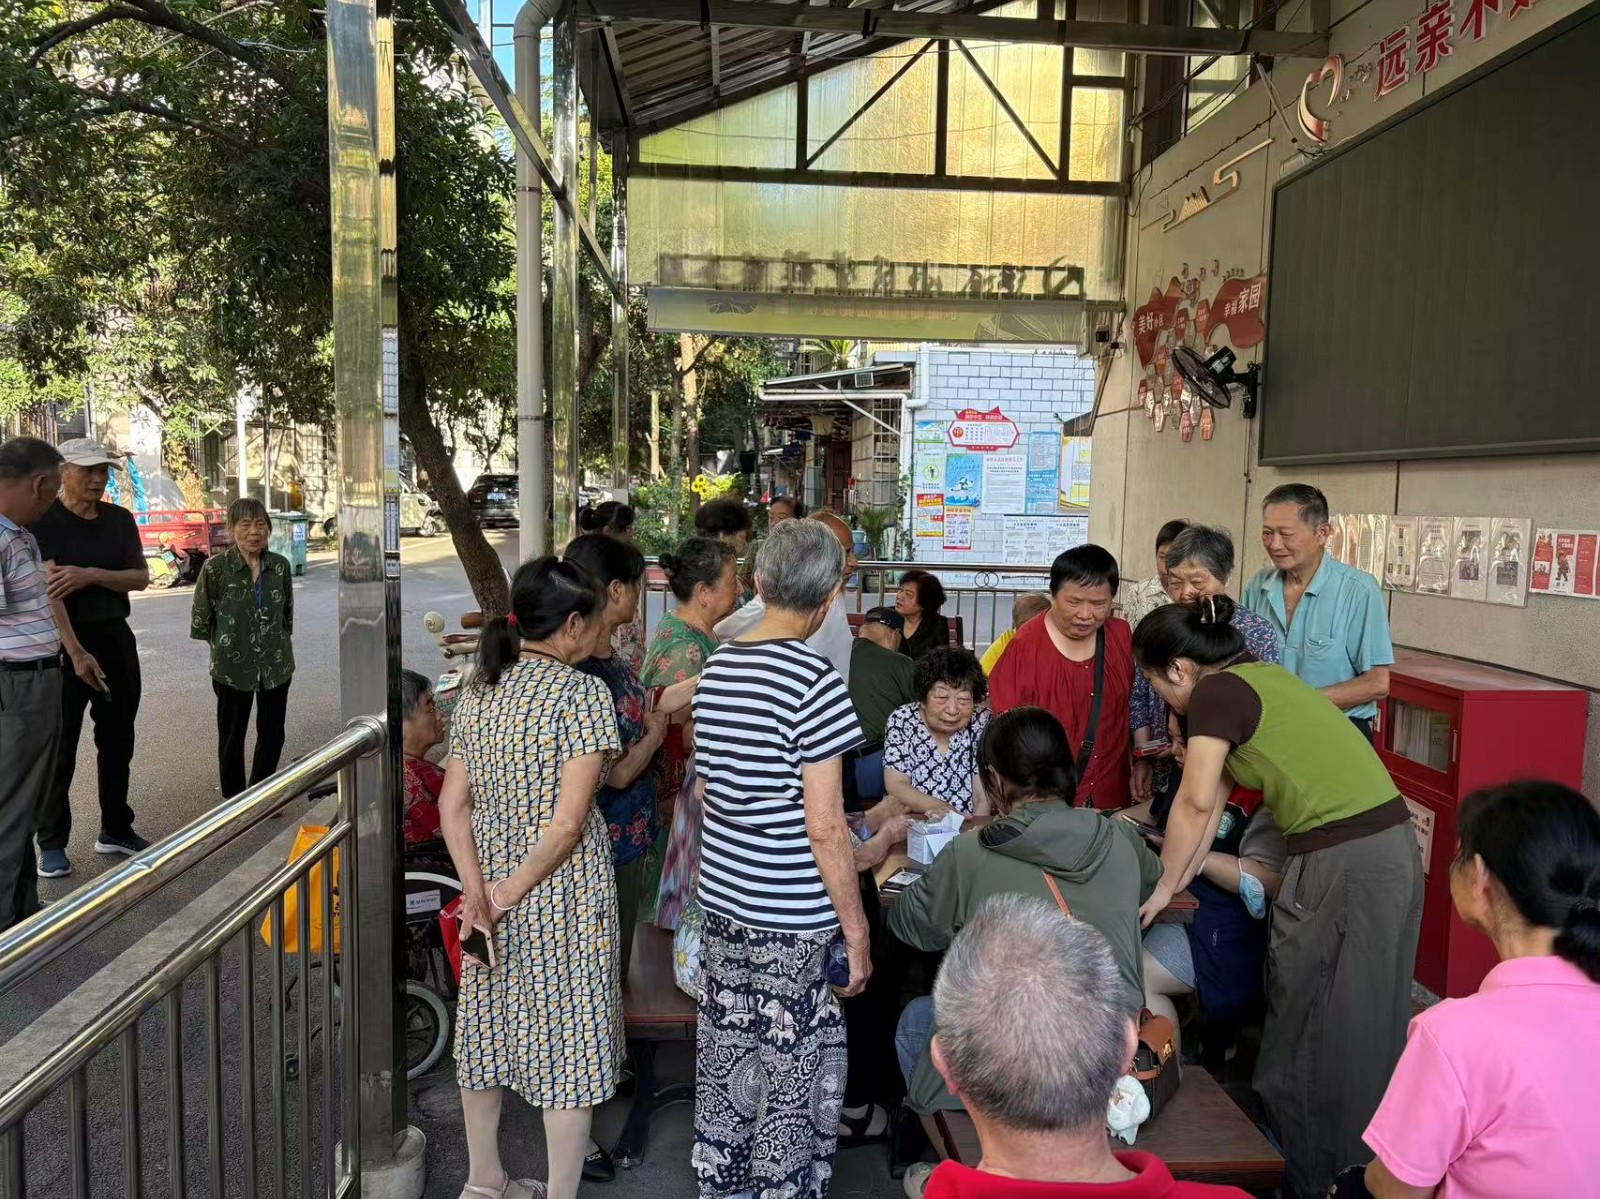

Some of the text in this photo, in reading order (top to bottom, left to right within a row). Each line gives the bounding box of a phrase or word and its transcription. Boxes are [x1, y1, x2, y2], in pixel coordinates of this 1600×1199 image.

[1224, 282, 1262, 318] 幸福家园
[1138, 312, 1164, 335] 美好小区
